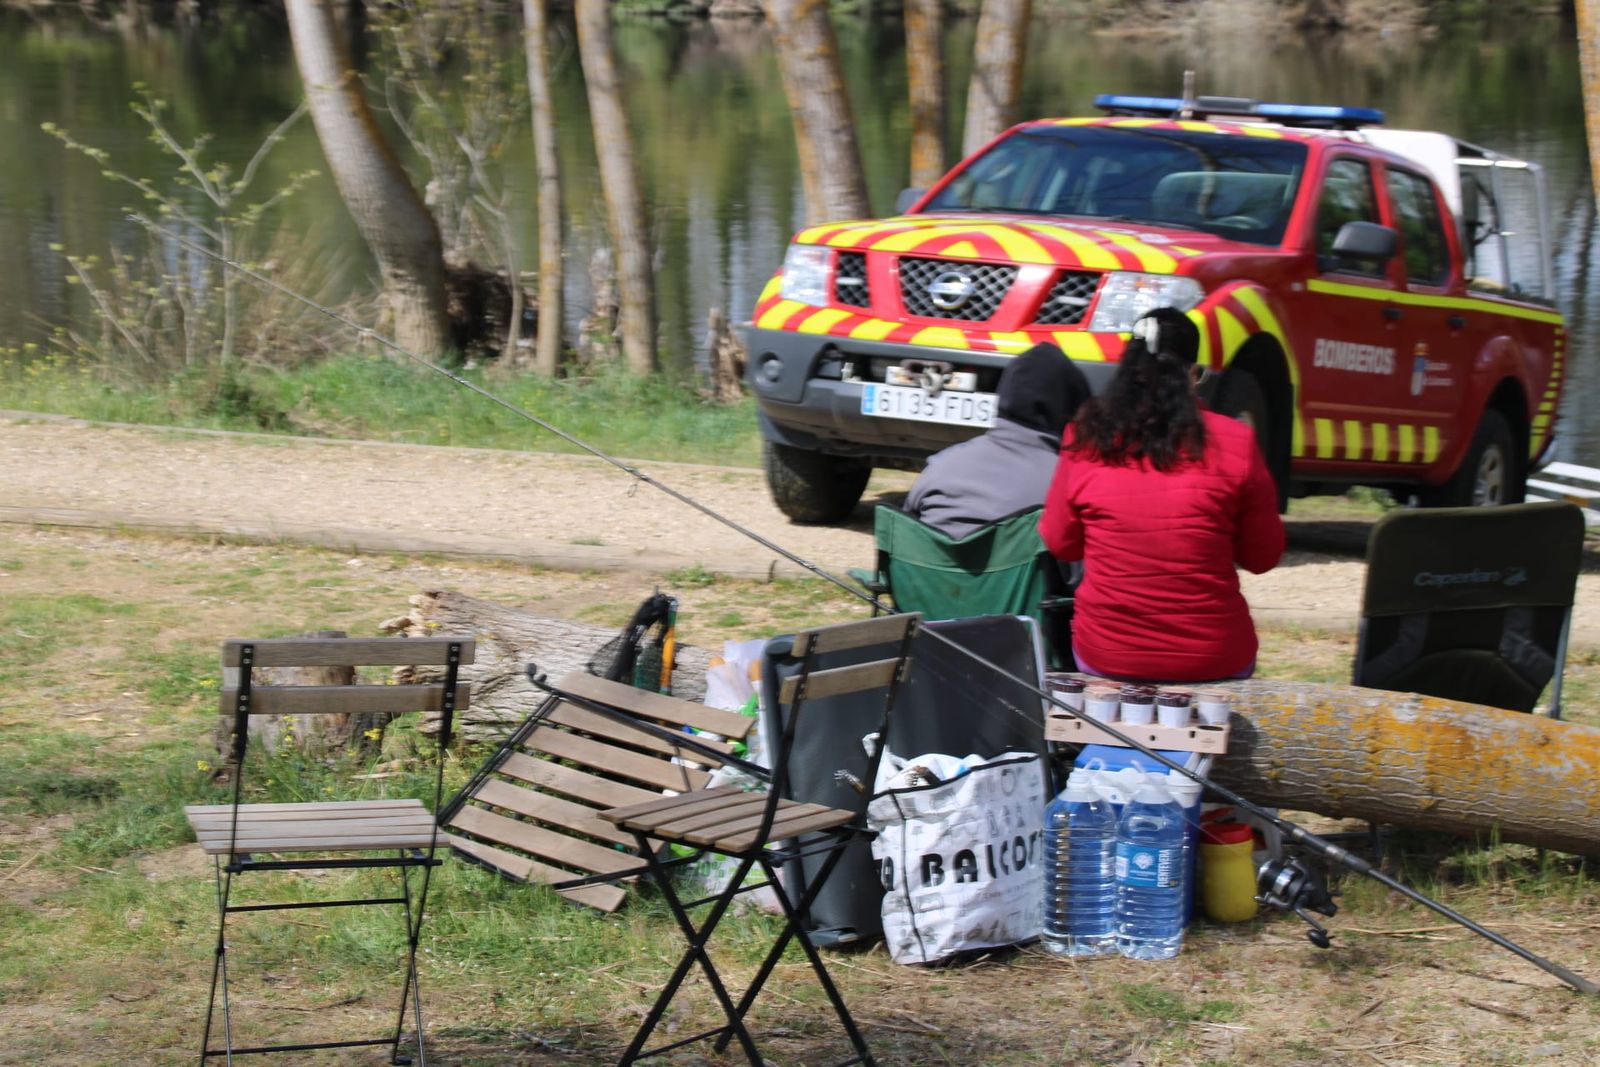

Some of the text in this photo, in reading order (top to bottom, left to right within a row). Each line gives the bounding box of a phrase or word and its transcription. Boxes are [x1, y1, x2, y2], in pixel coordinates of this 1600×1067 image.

[1312, 338, 1395, 375] BOMBEROS
[878, 390, 990, 422] 6135 FDS
